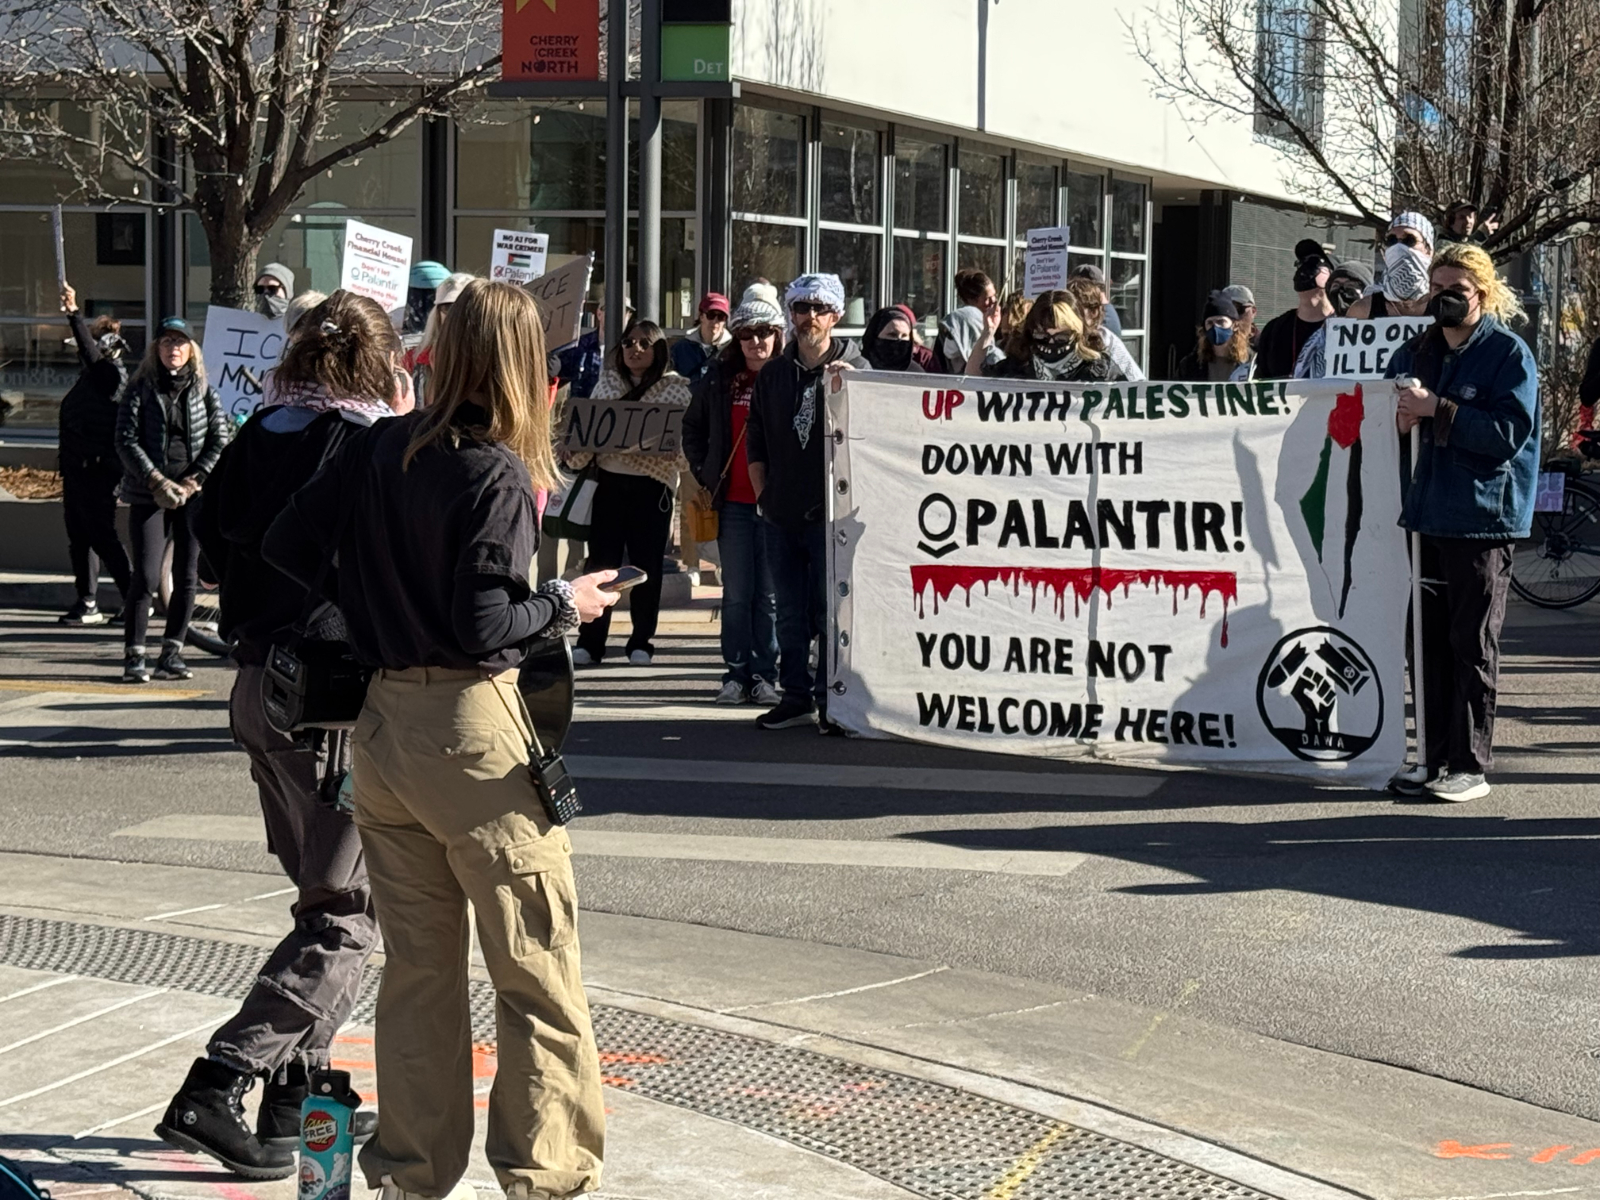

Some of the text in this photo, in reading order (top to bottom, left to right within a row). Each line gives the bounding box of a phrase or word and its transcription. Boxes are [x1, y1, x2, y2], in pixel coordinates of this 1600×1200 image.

[530, 35, 580, 47] CHERRY
[537, 48, 578, 58] CREEK
[521, 60, 578, 74] NORTH
[355, 232, 403, 254] Cherry Creek
[496, 242, 513, 250] WAR
[502, 234, 538, 244] NO AI FOR
[361, 271, 398, 290] Palantir
[922, 382, 1292, 422] UP WITH PALESTINE!
[921, 441, 1143, 477] DOWN WITH
[966, 498, 1246, 553] PALANTIR!
[916, 631, 1173, 683] YOU ARE NOT
[916, 691, 1238, 749] WELCOME HERE!
[1301, 733, 1345, 749] DAWA
